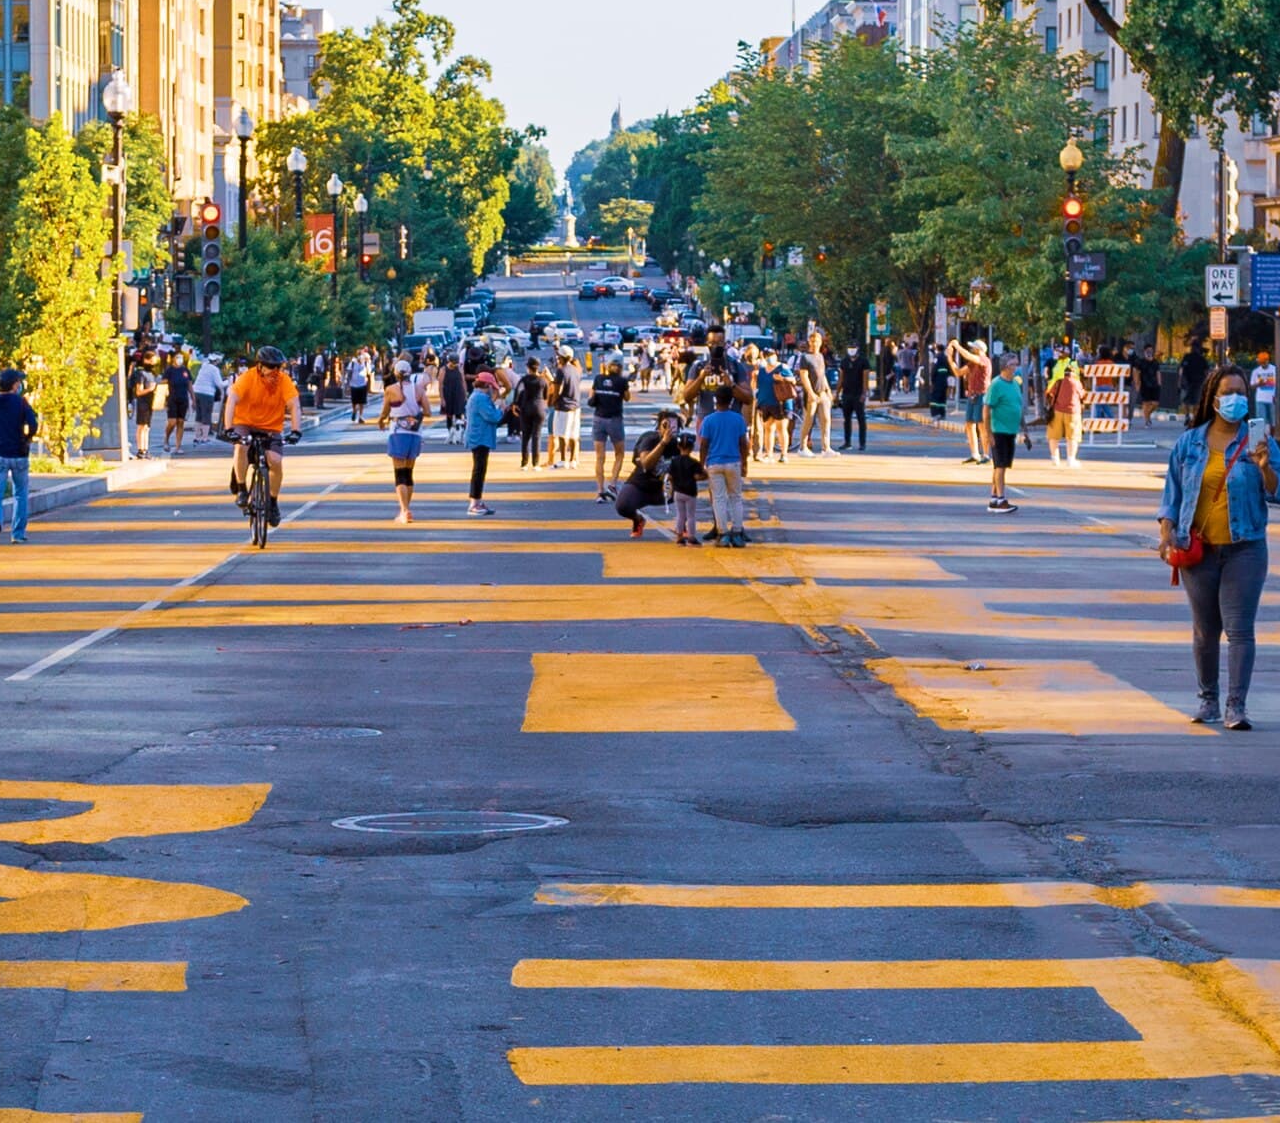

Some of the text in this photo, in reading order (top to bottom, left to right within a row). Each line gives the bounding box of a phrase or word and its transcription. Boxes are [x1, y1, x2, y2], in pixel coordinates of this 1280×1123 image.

[306, 229, 333, 255] 16
[1211, 269, 1235, 279] ONE
[1211, 280, 1236, 290] WAY
